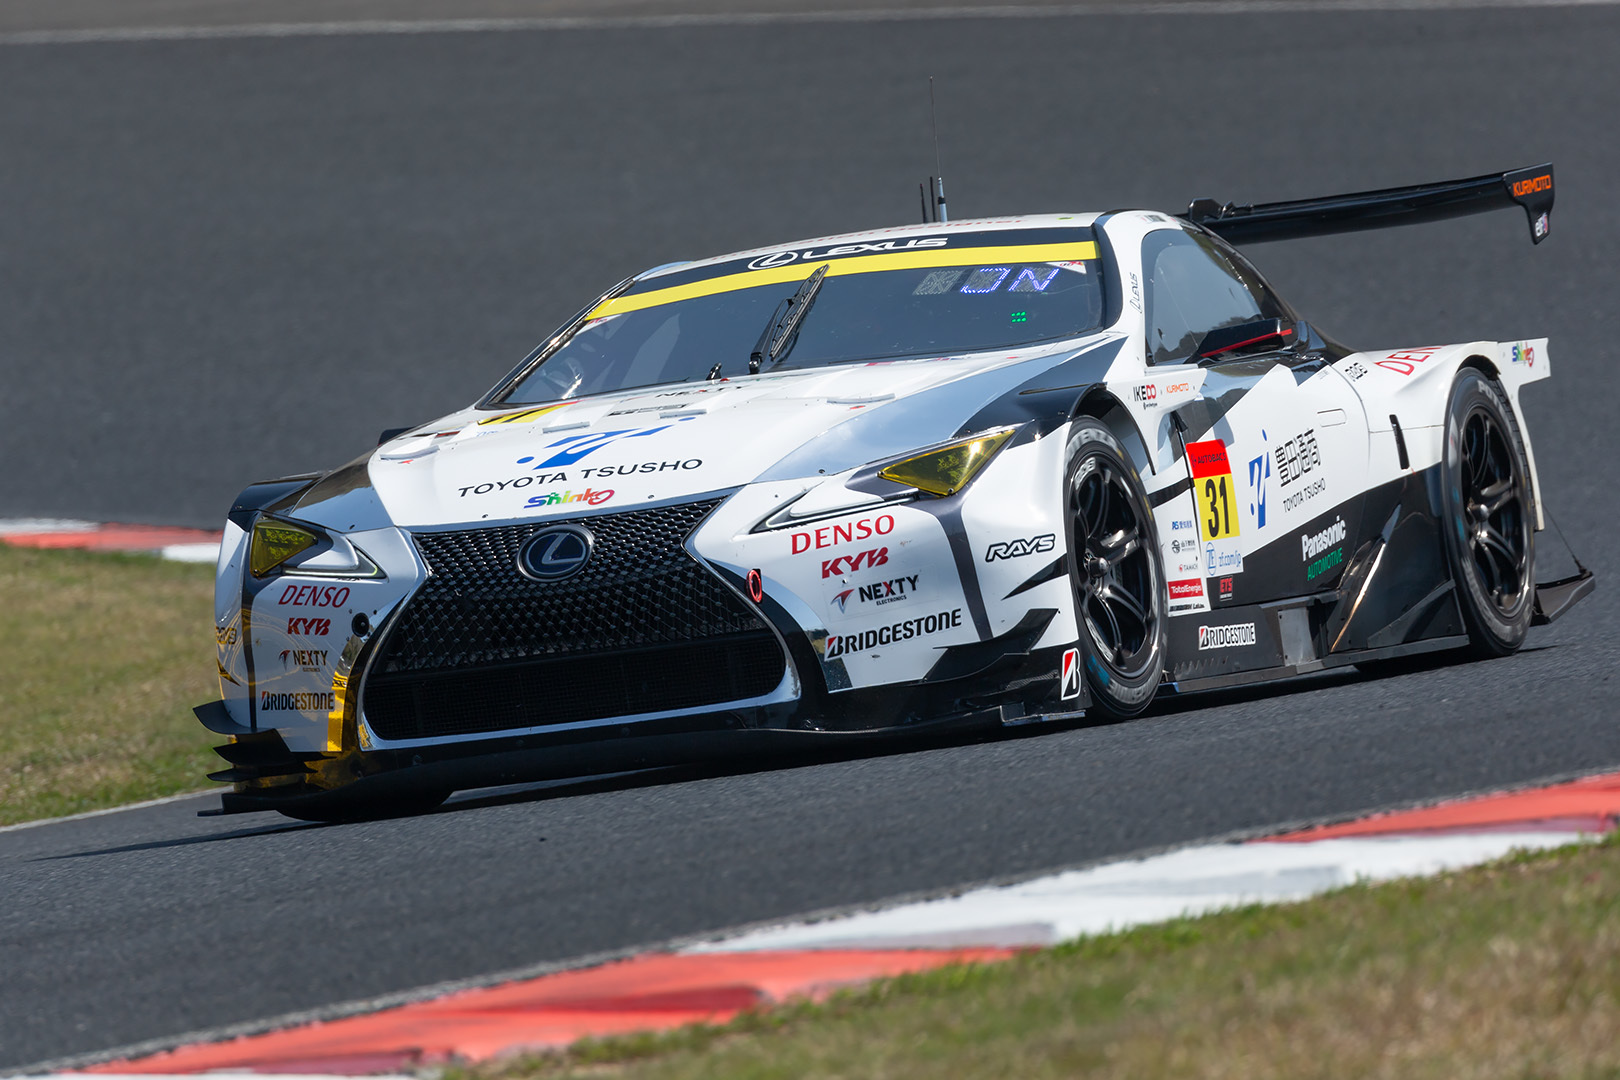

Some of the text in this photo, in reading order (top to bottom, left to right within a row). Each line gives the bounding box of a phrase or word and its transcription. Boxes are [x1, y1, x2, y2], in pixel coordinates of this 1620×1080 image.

[802, 237, 948, 259] LEXUS
[1373, 345, 1446, 376] DEN
[1197, 452, 1227, 465] AUTOBACS
[1275, 428, 1321, 488] 豊田通商
[458, 458, 703, 497] TOYOTA TSUSHO
[1205, 476, 1230, 538] 31
[1283, 477, 1326, 513] TOYOTA TSUSHO
[790, 514, 895, 555] DENSO
[985, 533, 1055, 562] RAYS
[1301, 515, 1346, 562] Panasonic
[821, 546, 889, 579] KYB
[1218, 550, 1242, 568] zf.com/jp
[1307, 547, 1343, 581] AUTOMOTIVE
[278, 585, 351, 608] DENSO
[858, 574, 919, 603] NEXTY
[876, 594, 907, 606] ELECTRONICS
[287, 617, 331, 636] KYB
[825, 607, 962, 661] BRIDGESTONE
[1199, 624, 1255, 649] BRIDGESTONE
[292, 650, 328, 667] NEXTY
[261, 691, 335, 711] BRIDGESTONE
